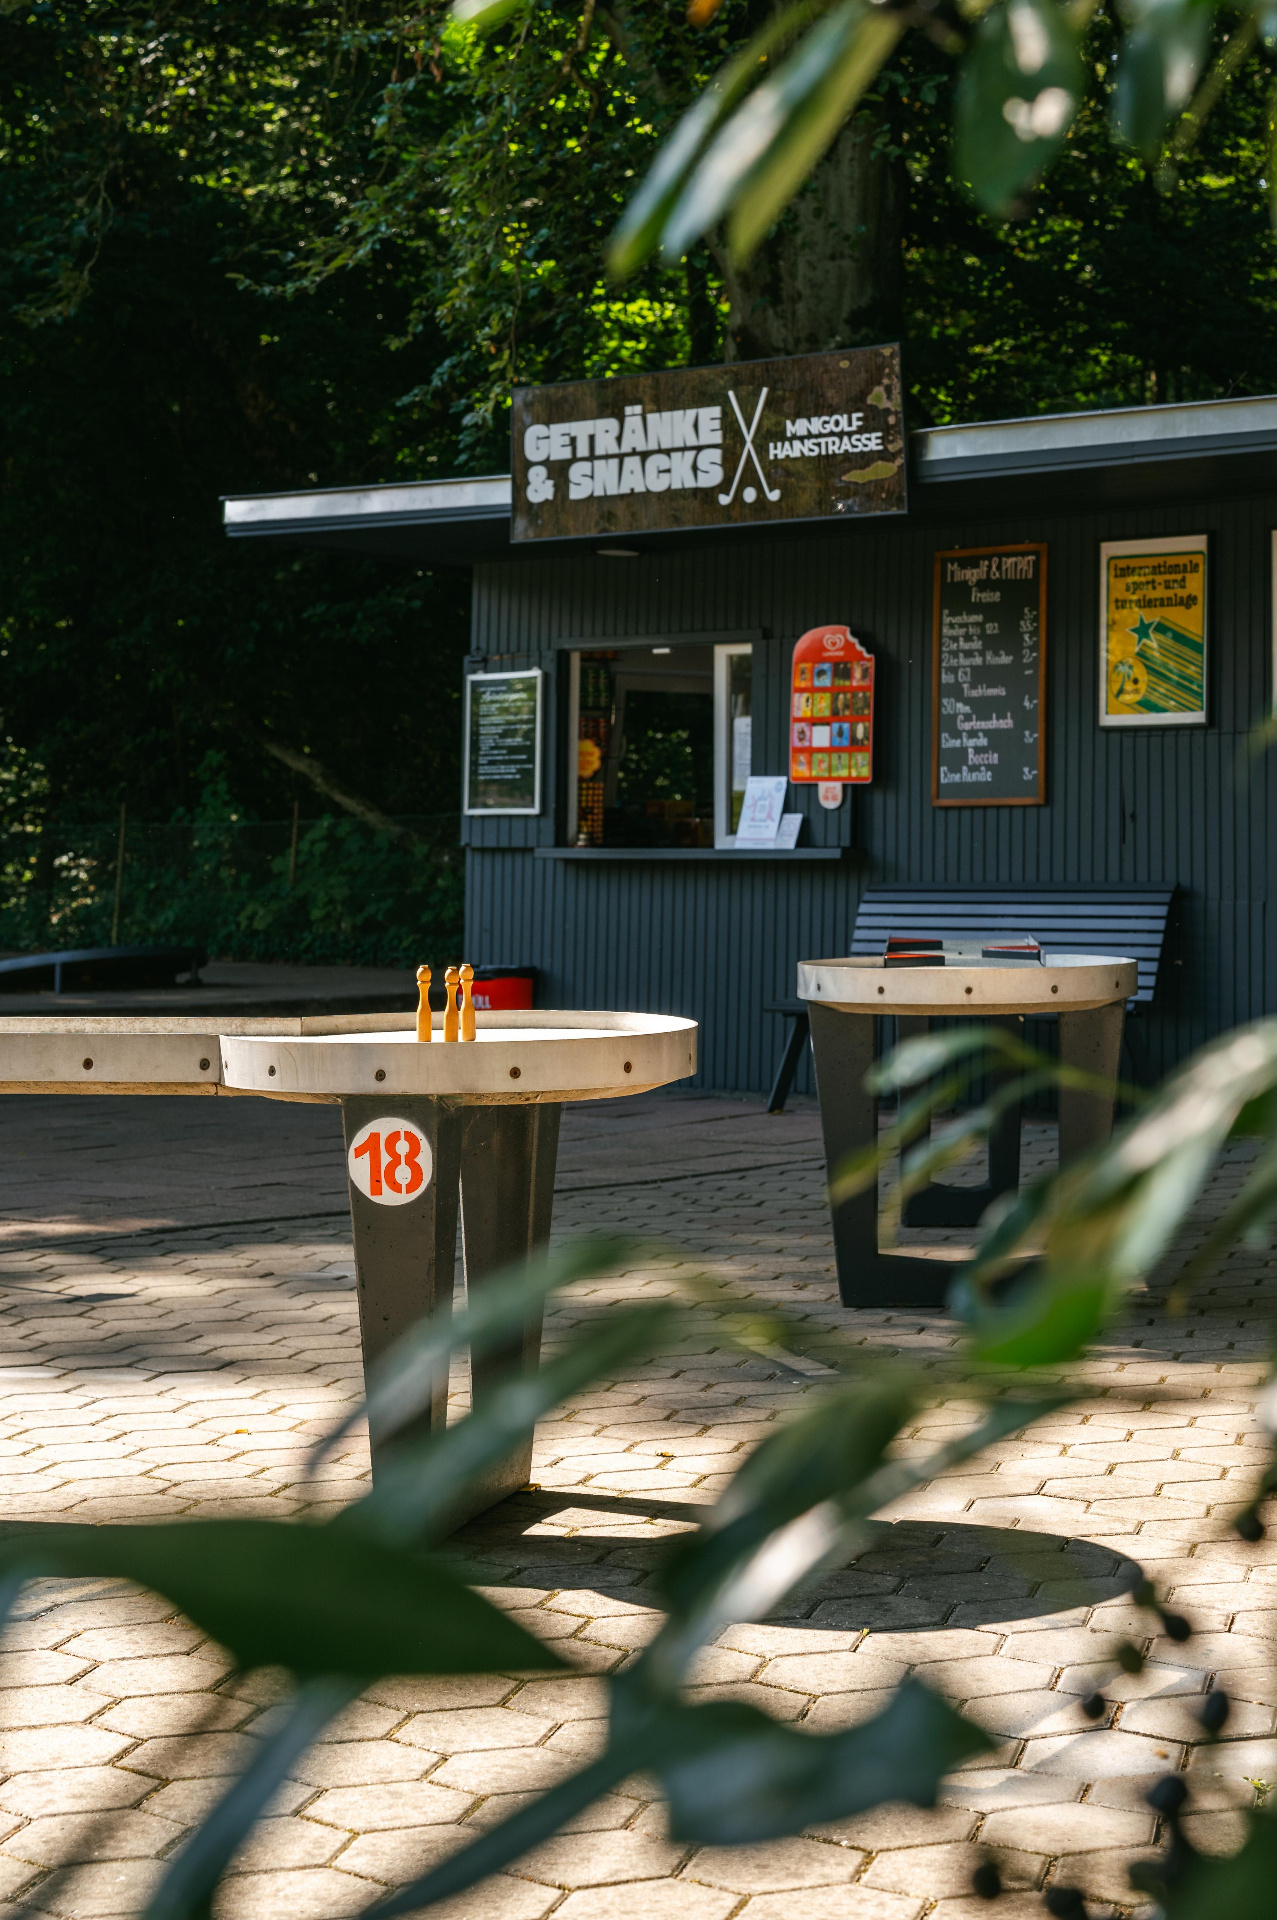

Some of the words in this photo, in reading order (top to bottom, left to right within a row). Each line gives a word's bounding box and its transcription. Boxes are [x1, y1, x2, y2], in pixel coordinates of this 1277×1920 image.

[524, 404, 723, 463] GETRÄNKE
[786, 412, 864, 438] MINIGOLF
[768, 431, 884, 460] HAINSTRASSE
[526, 465, 555, 503] &
[568, 448, 724, 500] SNACKS
[947, 560, 989, 586] Minigolf
[990, 557, 1000, 580] &
[1113, 560, 1200, 578] internationale
[971, 587, 1001, 602] Preise
[1114, 593, 1198, 610] turnieranlage
[958, 636, 982, 650] Runde
[958, 652, 983, 666] Runde
[985, 650, 1014, 665] Kinder
[962, 683, 1006, 697] Tischtennis
[957, 711, 1014, 730] Gartenschach
[941, 732, 961, 748] Eine
[962, 731, 988, 747] Runde
[968, 748, 999, 765] Boccia
[940, 766, 961, 784] Eine
[962, 765, 992, 782] Runde
[354, 1131, 423, 1196] 18
